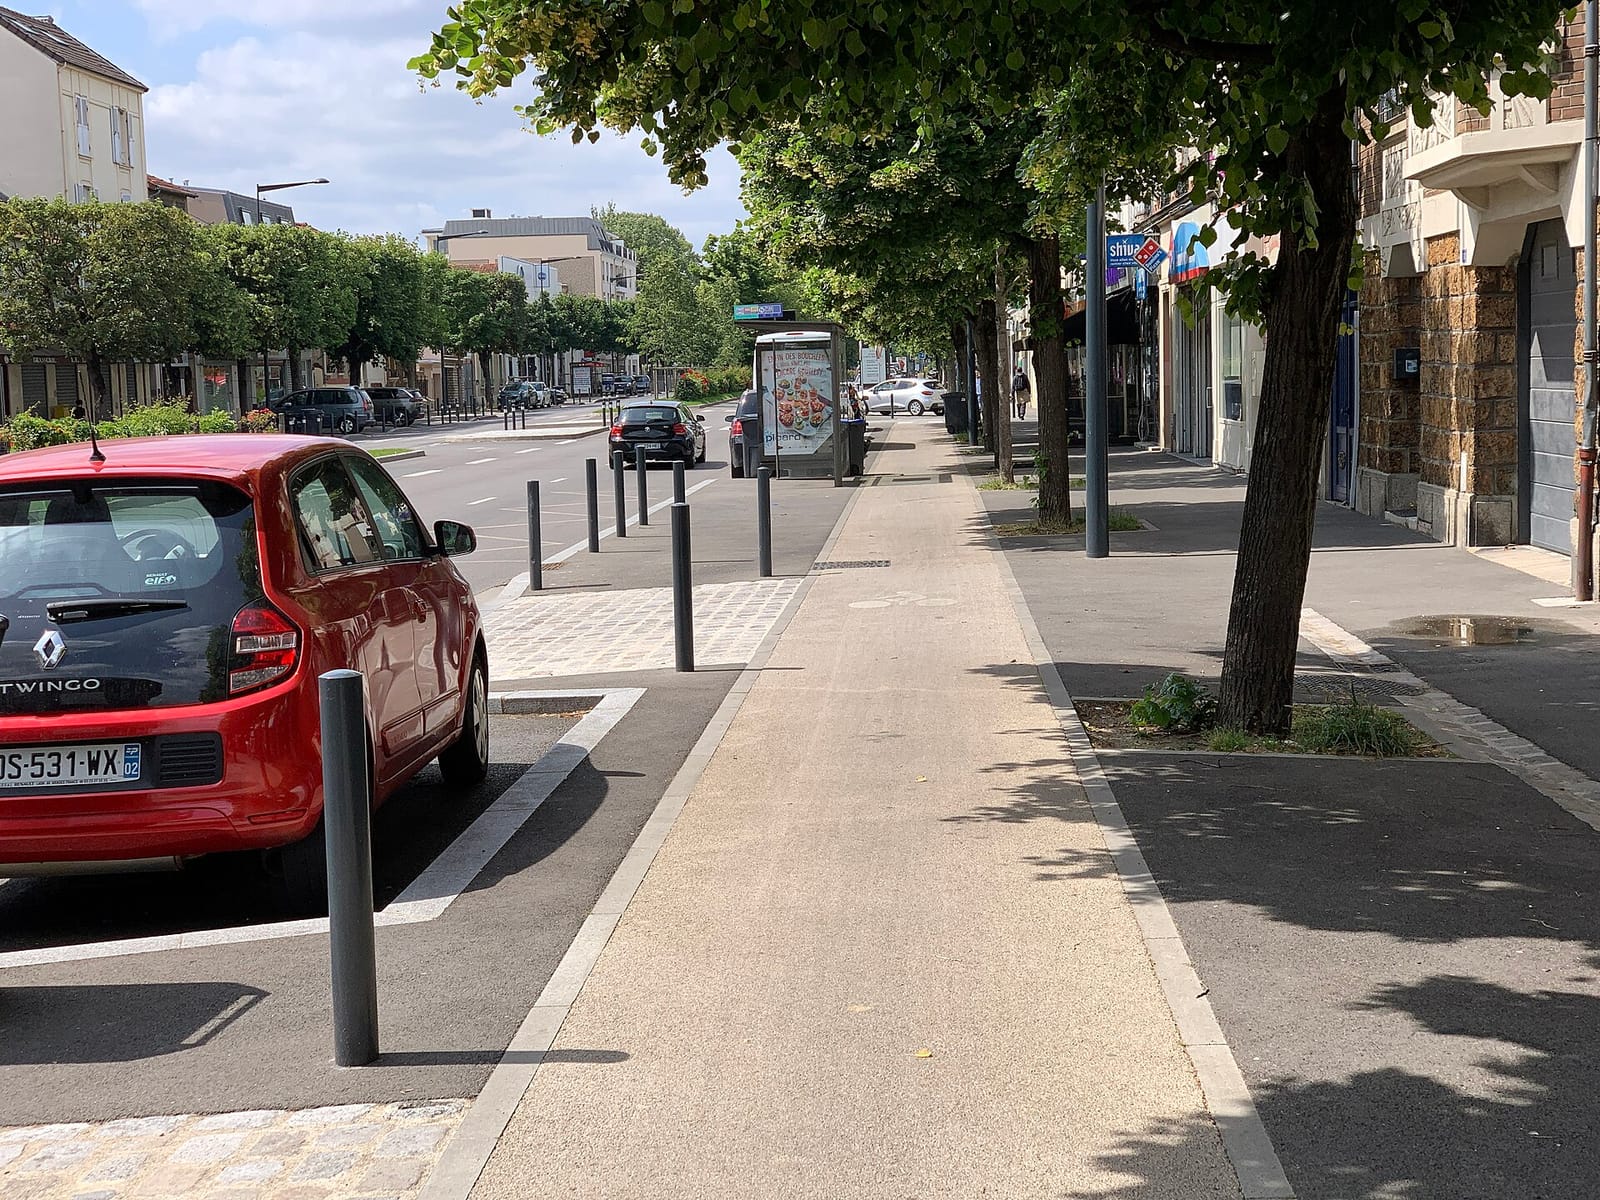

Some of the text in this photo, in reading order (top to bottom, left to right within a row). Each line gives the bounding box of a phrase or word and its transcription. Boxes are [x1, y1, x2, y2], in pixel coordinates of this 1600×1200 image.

[1110, 239, 1140, 257] shiva
[0, 678, 100, 695] TWINGO
[124, 762, 138, 775] 02
